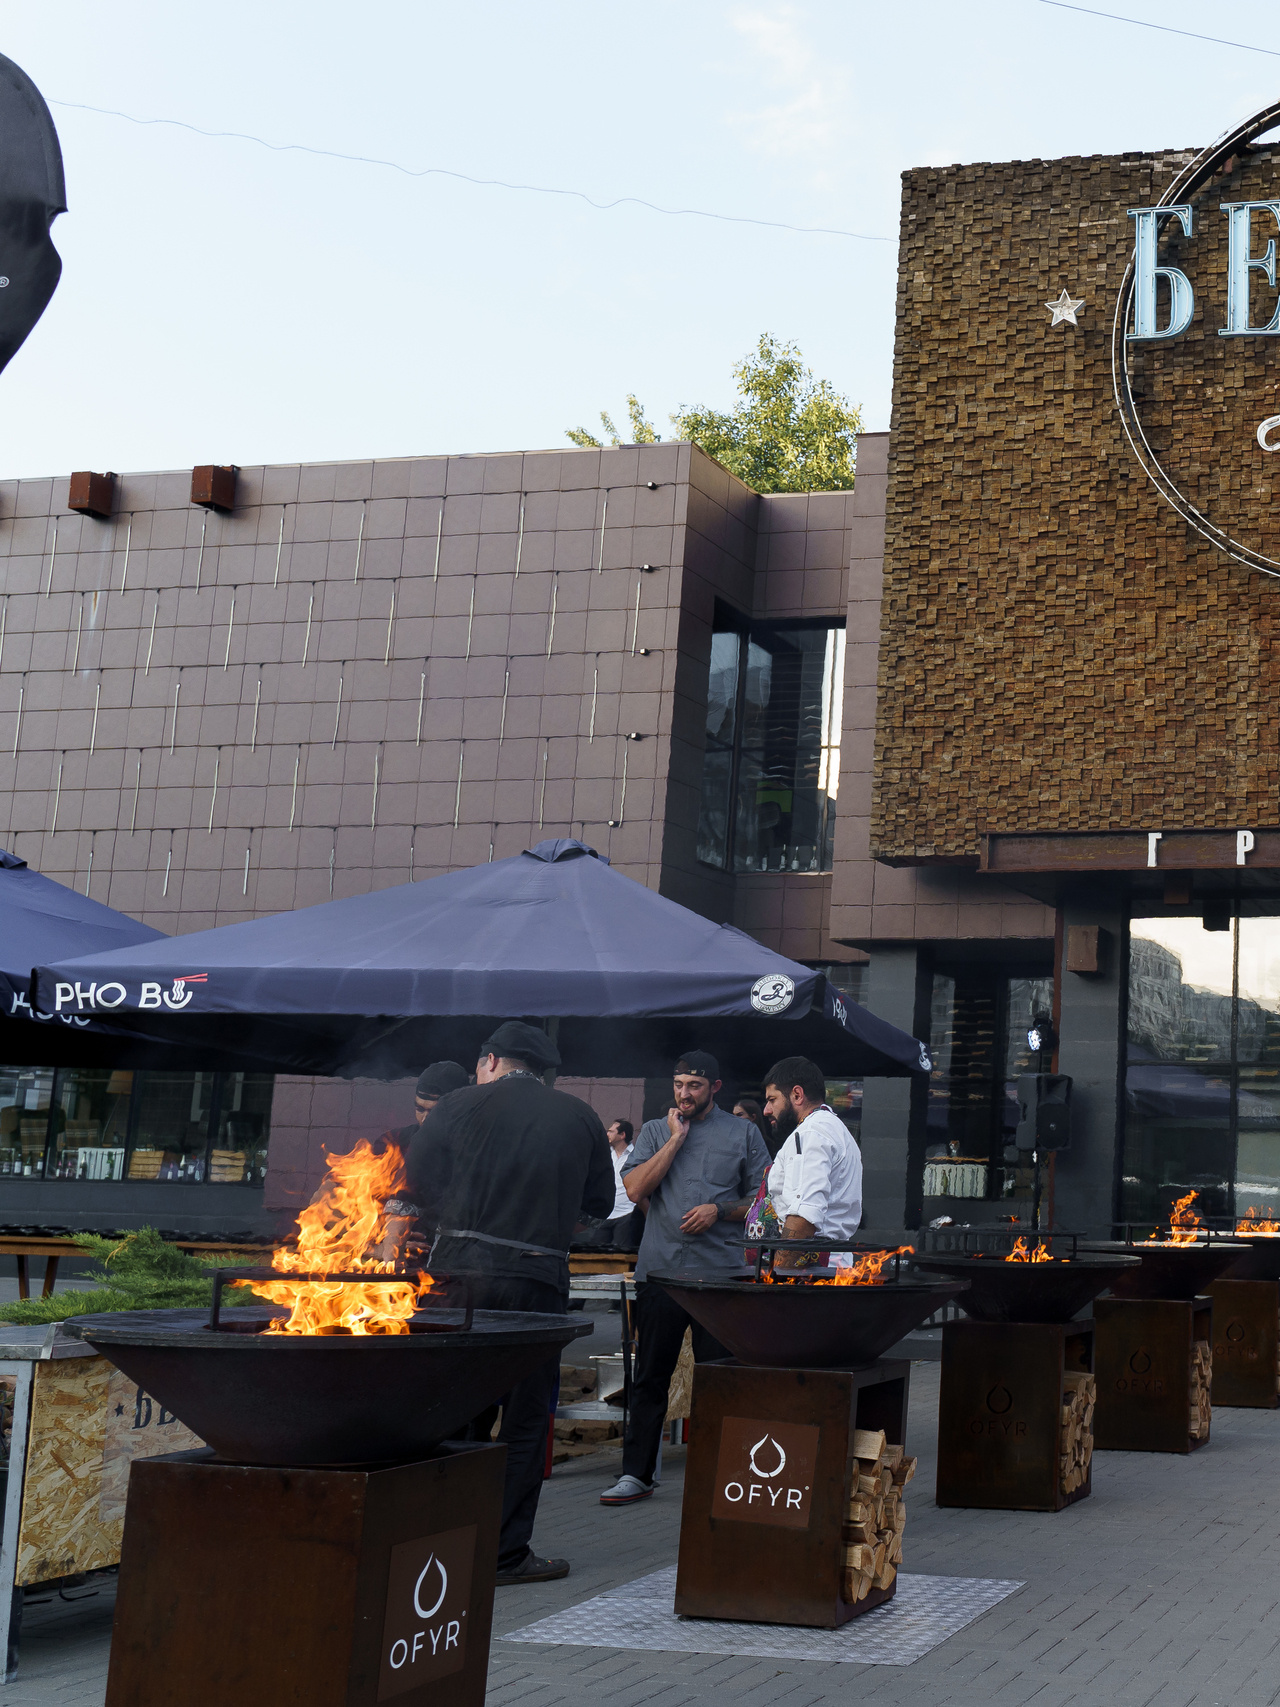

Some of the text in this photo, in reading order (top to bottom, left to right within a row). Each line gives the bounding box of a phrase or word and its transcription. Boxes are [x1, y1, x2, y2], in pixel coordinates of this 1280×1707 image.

[55, 982, 127, 1011] PHO
[1116, 1378, 1164, 1393] OFYR
[725, 1482, 803, 1510] OFYR
[389, 1620, 460, 1669] OFYR
